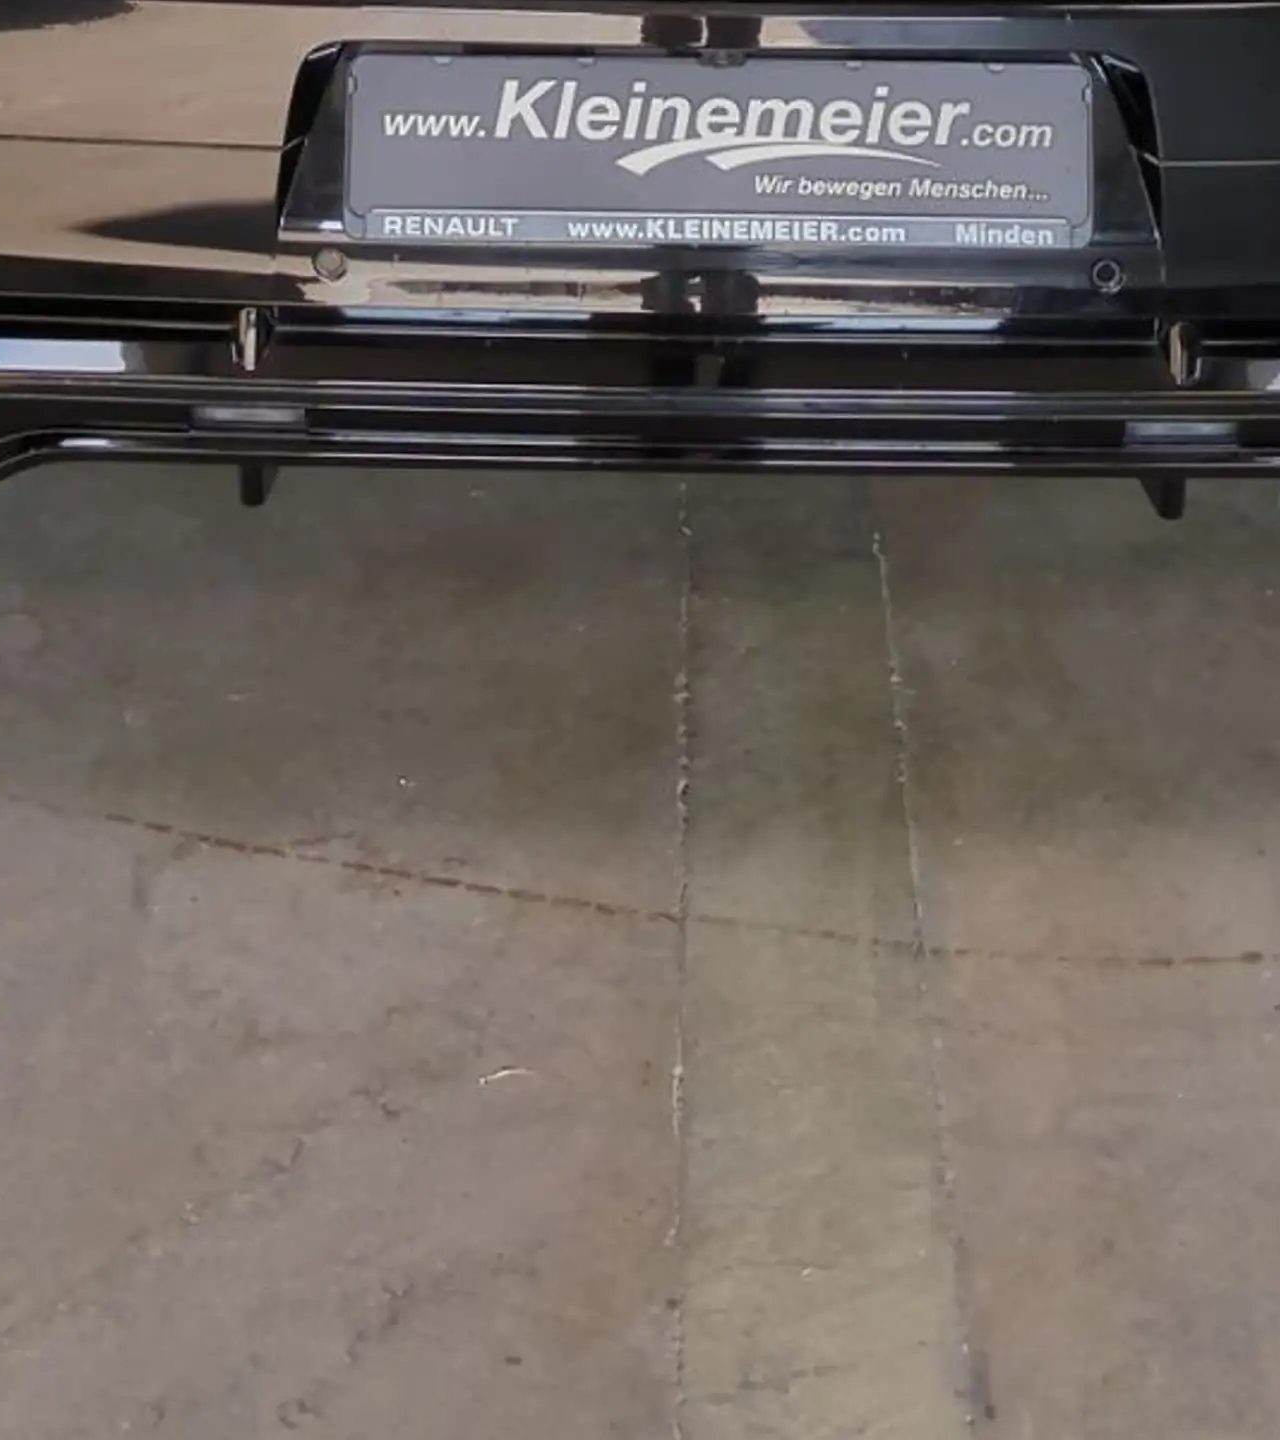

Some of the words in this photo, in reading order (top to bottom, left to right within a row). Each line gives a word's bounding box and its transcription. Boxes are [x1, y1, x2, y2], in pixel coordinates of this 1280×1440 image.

[754, 174, 794, 196] Wir
[798, 176, 901, 201] bewegen
[908, 177, 1048, 201] Menschen...
[383, 215, 519, 237] RENAULT
[567, 217, 905, 243] www.KLEINEMEIER.com
[954, 223, 1054, 246] Minden
